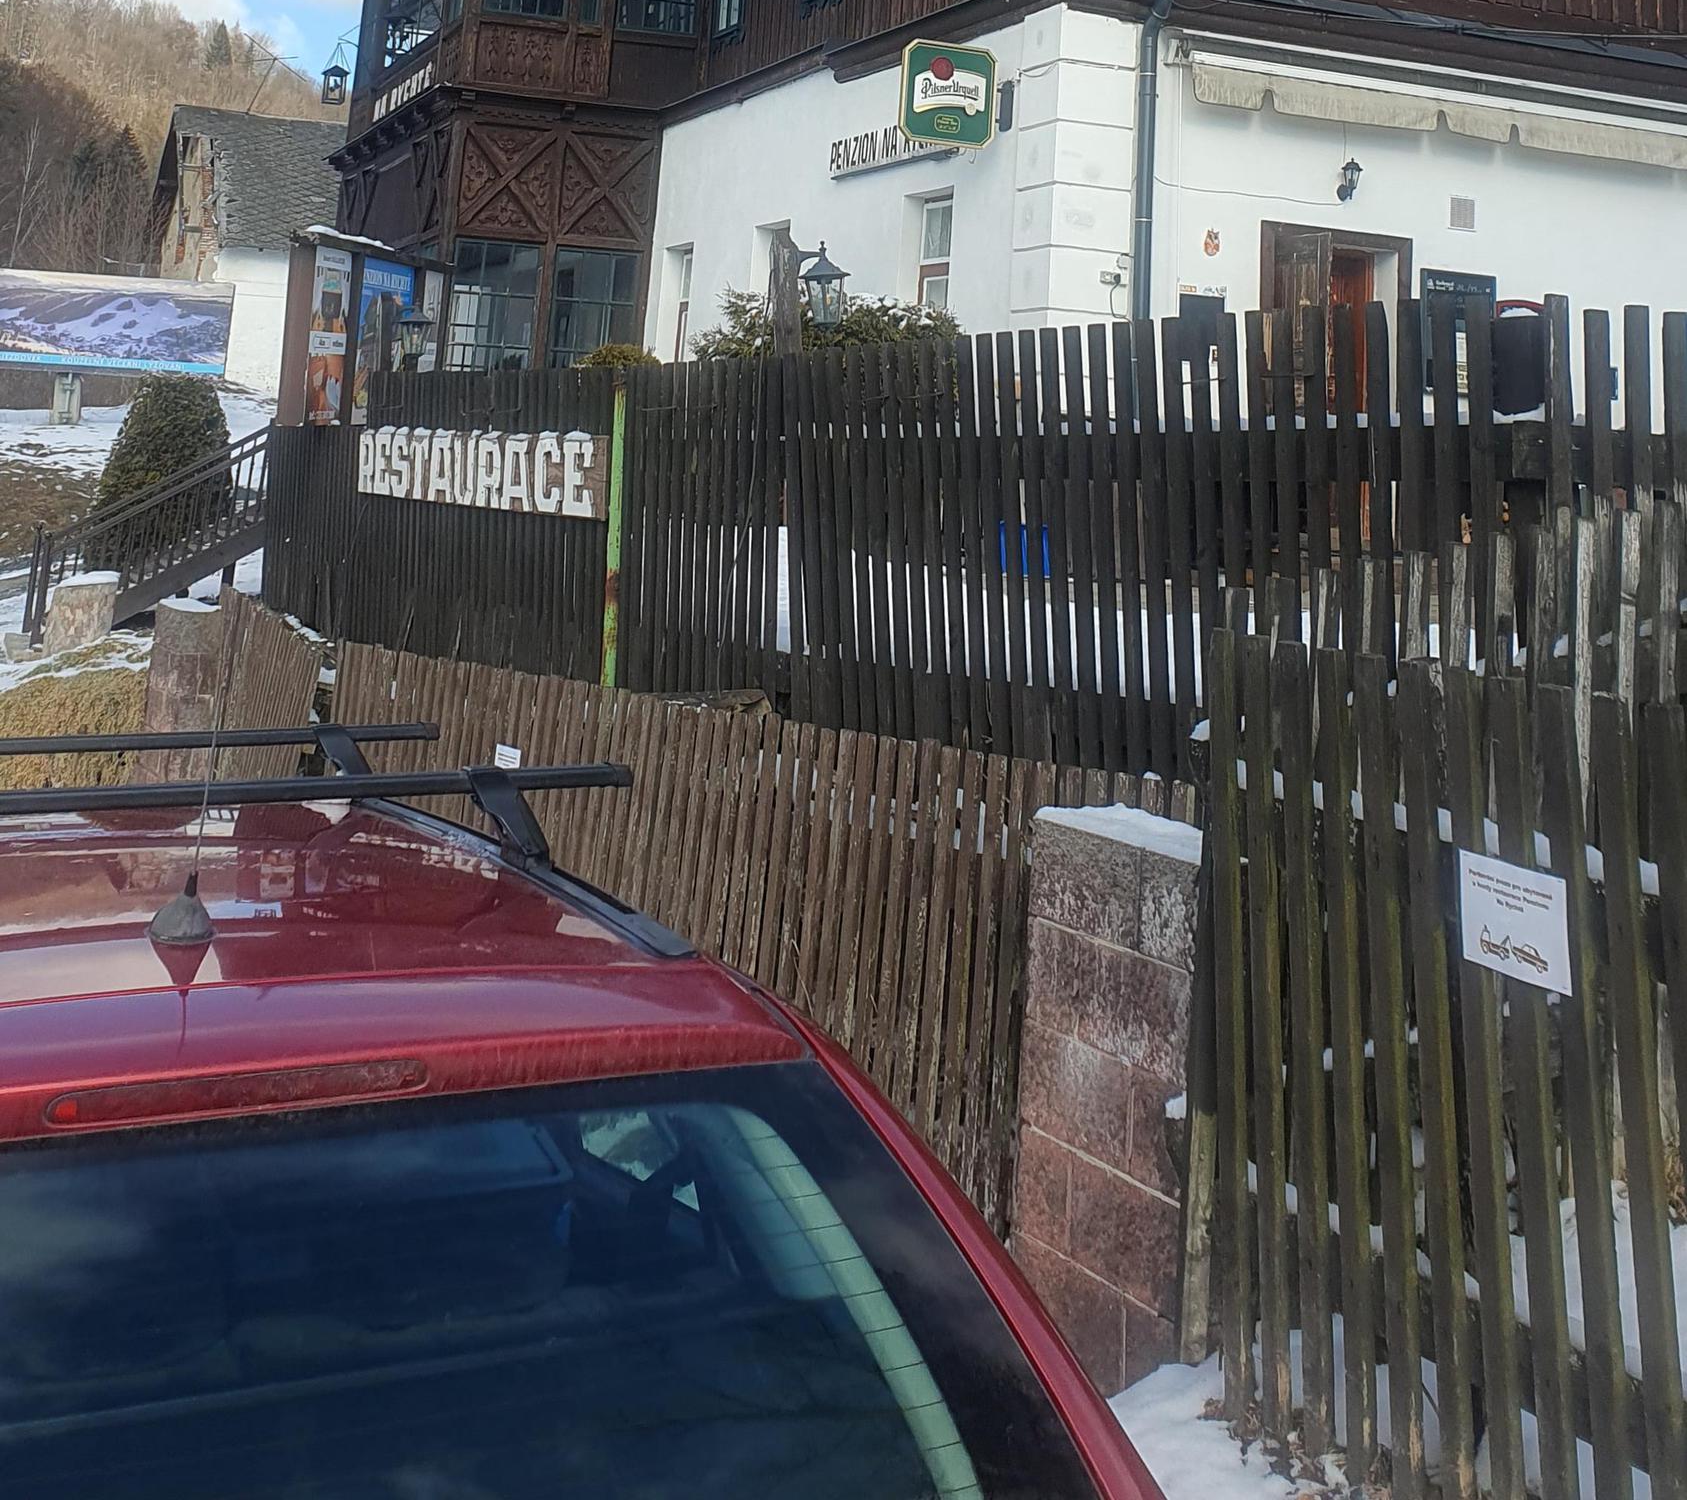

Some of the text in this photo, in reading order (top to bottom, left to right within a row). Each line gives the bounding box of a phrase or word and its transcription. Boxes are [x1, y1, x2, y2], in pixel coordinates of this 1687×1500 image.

[372, 93, 388, 122] NA
[921, 77, 979, 100] Pilsner Urquell
[829, 130, 878, 172] PENZION
[881, 125, 898, 159] NA
[358, 432, 594, 518] RESTAURACE
